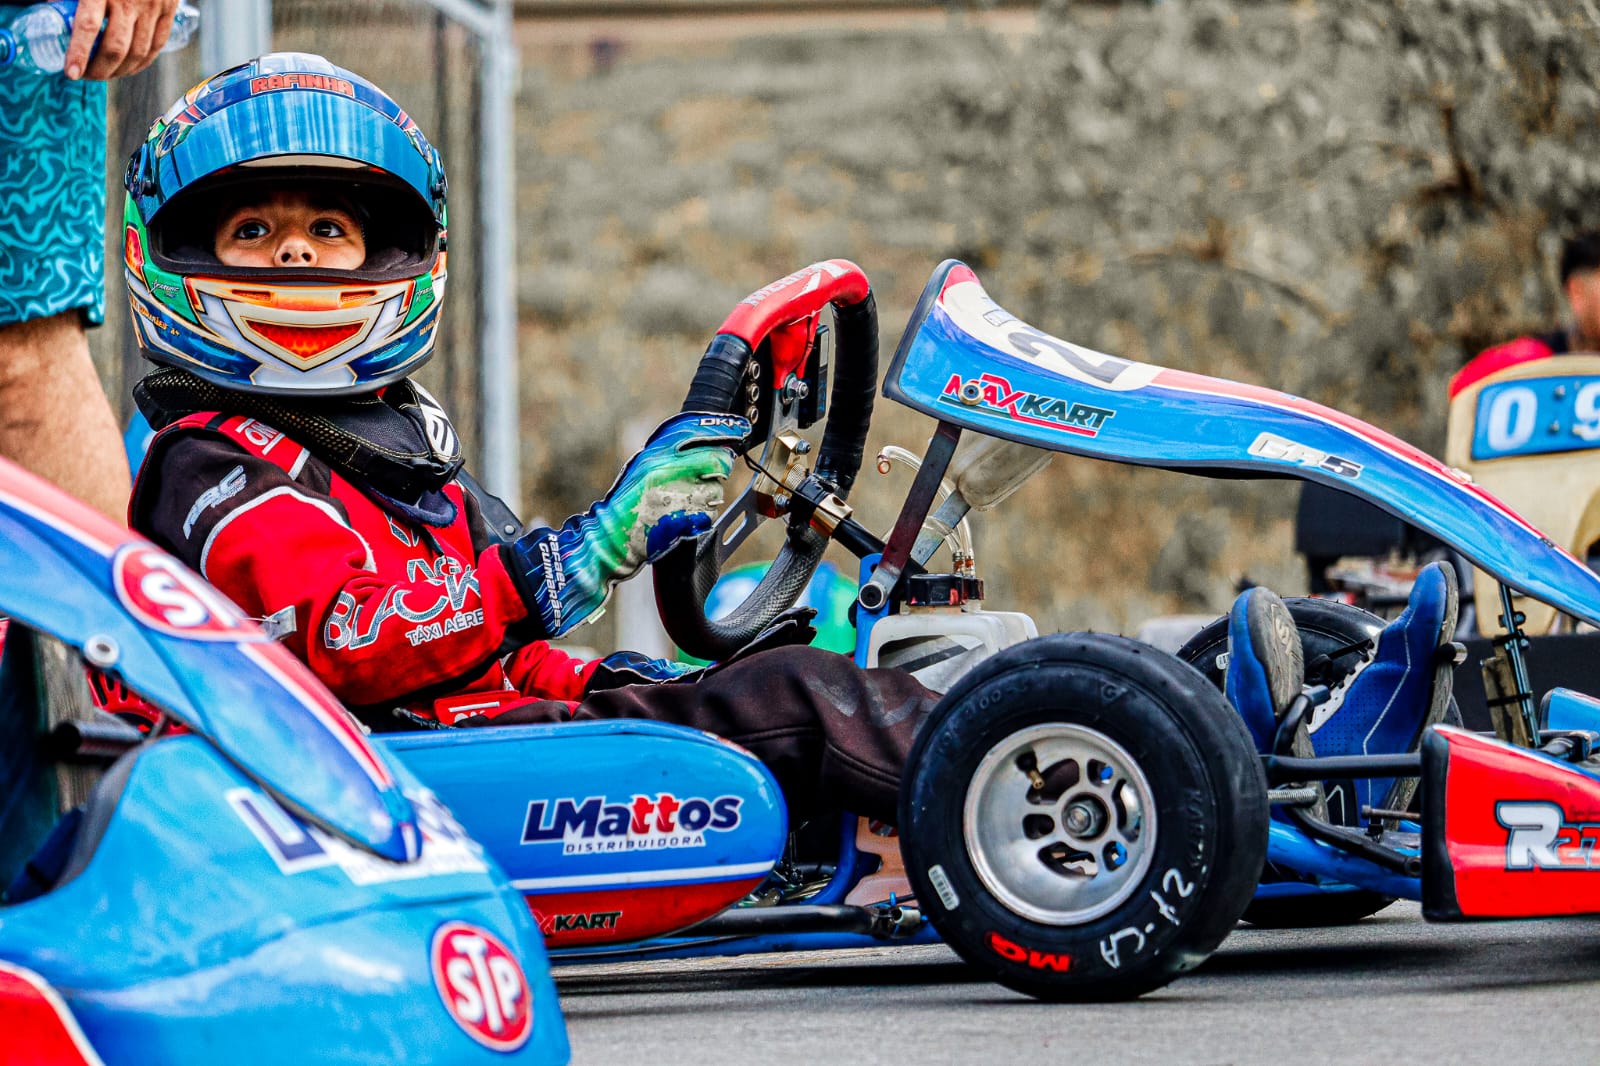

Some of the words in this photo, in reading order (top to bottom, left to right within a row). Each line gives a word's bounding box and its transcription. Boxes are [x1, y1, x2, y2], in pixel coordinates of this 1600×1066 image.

[251, 73, 355, 98] RAFINHA
[1007, 331, 1129, 384] 2
[406, 623, 443, 645] TÁXI
[445, 609, 484, 635] AÉRE
[522, 794, 743, 843] LMattos
[566, 835, 703, 854] DISTRIBUIDORA
[446, 935, 522, 1033] STP
